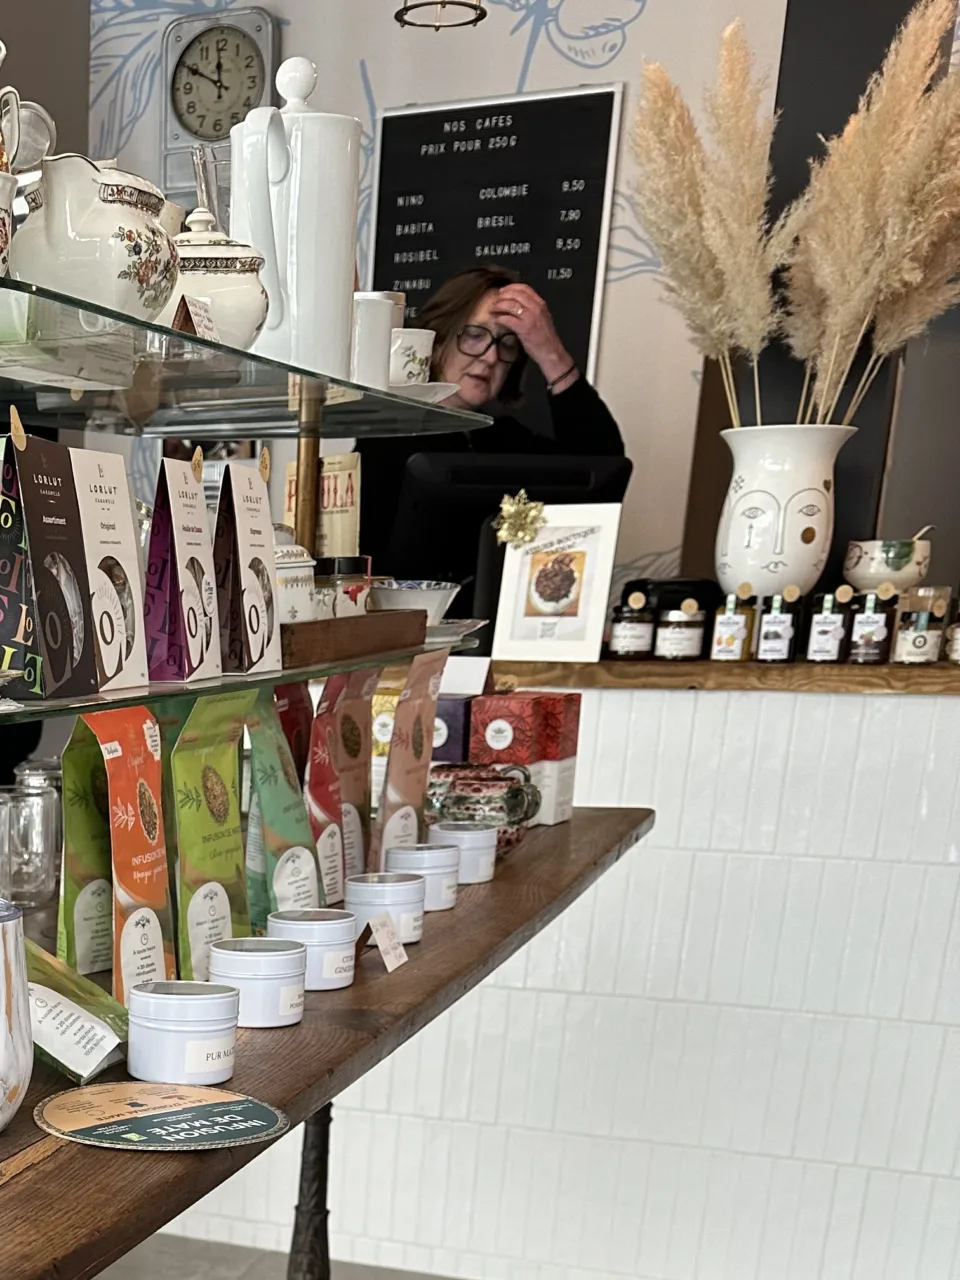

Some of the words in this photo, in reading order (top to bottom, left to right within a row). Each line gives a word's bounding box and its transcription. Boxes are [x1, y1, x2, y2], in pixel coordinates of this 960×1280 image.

[200, 46, 209, 61] 11
[236, 43, 240, 57] 1
[245, 55, 254, 69] 2
[183, 82, 193, 95] 9
[248, 76, 257, 90] 3
[186, 101, 196, 114] 8
[243, 96, 252, 108] 4
[197, 114, 206, 129] 7
[213, 118, 223, 132] 6
[444, 120, 466, 133] NOS
[476, 115, 513, 130] CAFES
[421, 143, 446, 156] PRIX
[453, 140, 481, 152] POUR
[480, 184, 529, 199] COLOMBIE
[396, 222, 434, 236] BABITA
[477, 216, 515, 228] BRESIL
[476, 242, 531, 257] SALVADOR
[33, 474, 62, 487] LORLUT
[89, 484, 118, 496] LORLUT
[178, 490, 199, 501] LORLUT
[206, 1051, 222, 1062] PUR
[210, 1114, 245, 1124] DE
[146, 1119, 212, 1135] MATÉ
[162, 1118, 268, 1142] INFUSION
